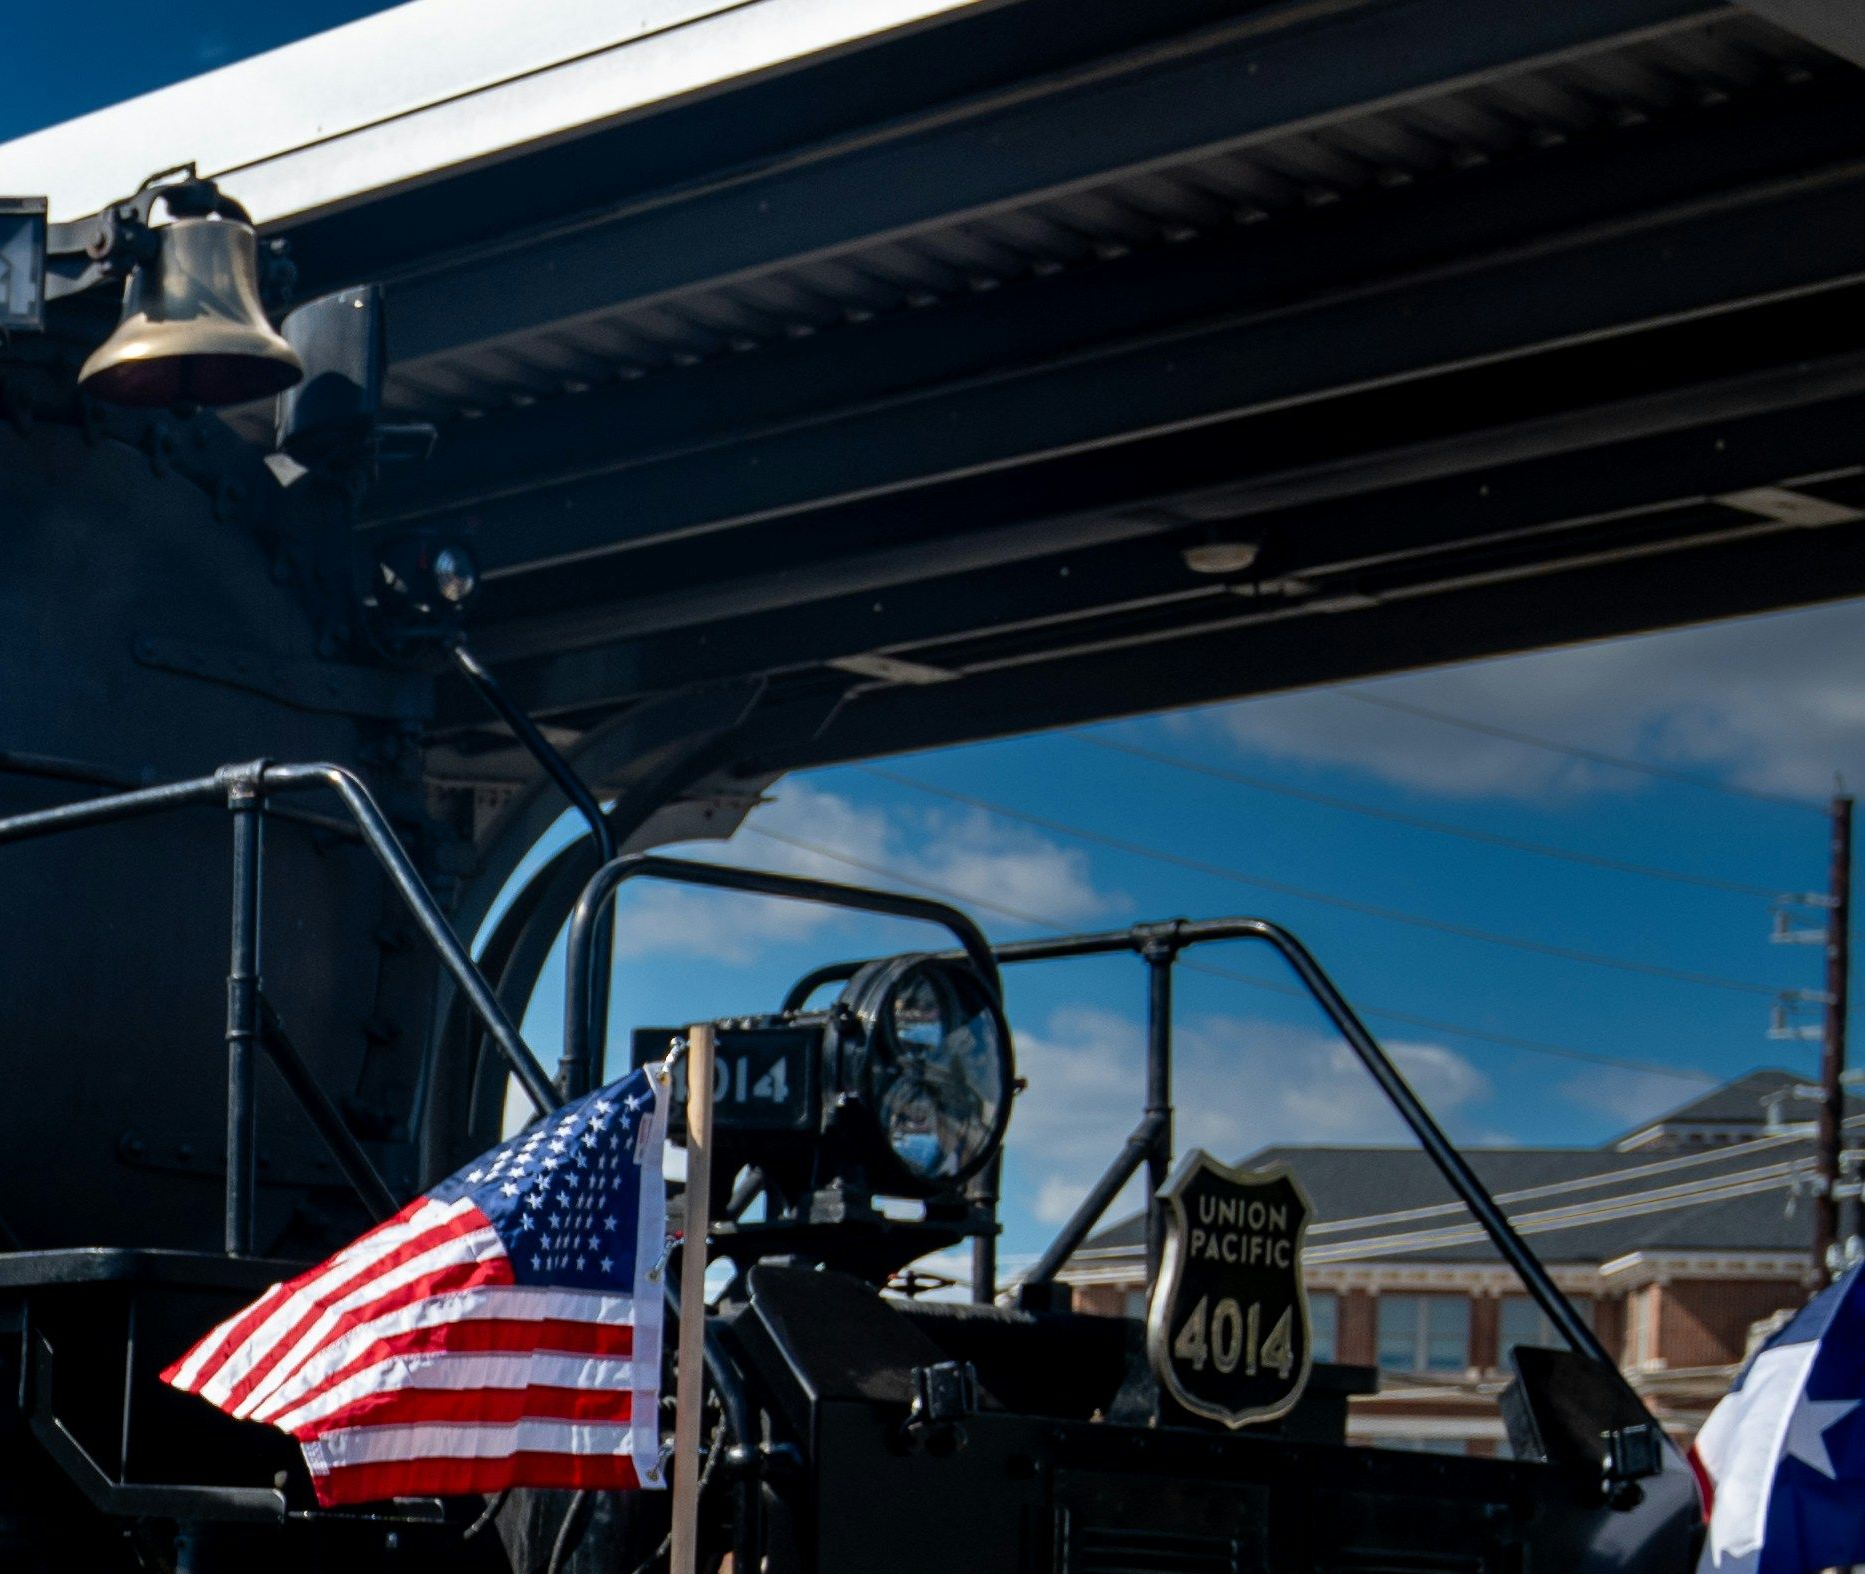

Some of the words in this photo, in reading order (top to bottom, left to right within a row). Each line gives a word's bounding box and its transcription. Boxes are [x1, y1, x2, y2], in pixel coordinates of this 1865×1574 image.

[1199, 1195, 1288, 1231] UNION
[1190, 1229, 1291, 1268] PACIFIC
[1174, 1294, 1294, 1380] 4014
